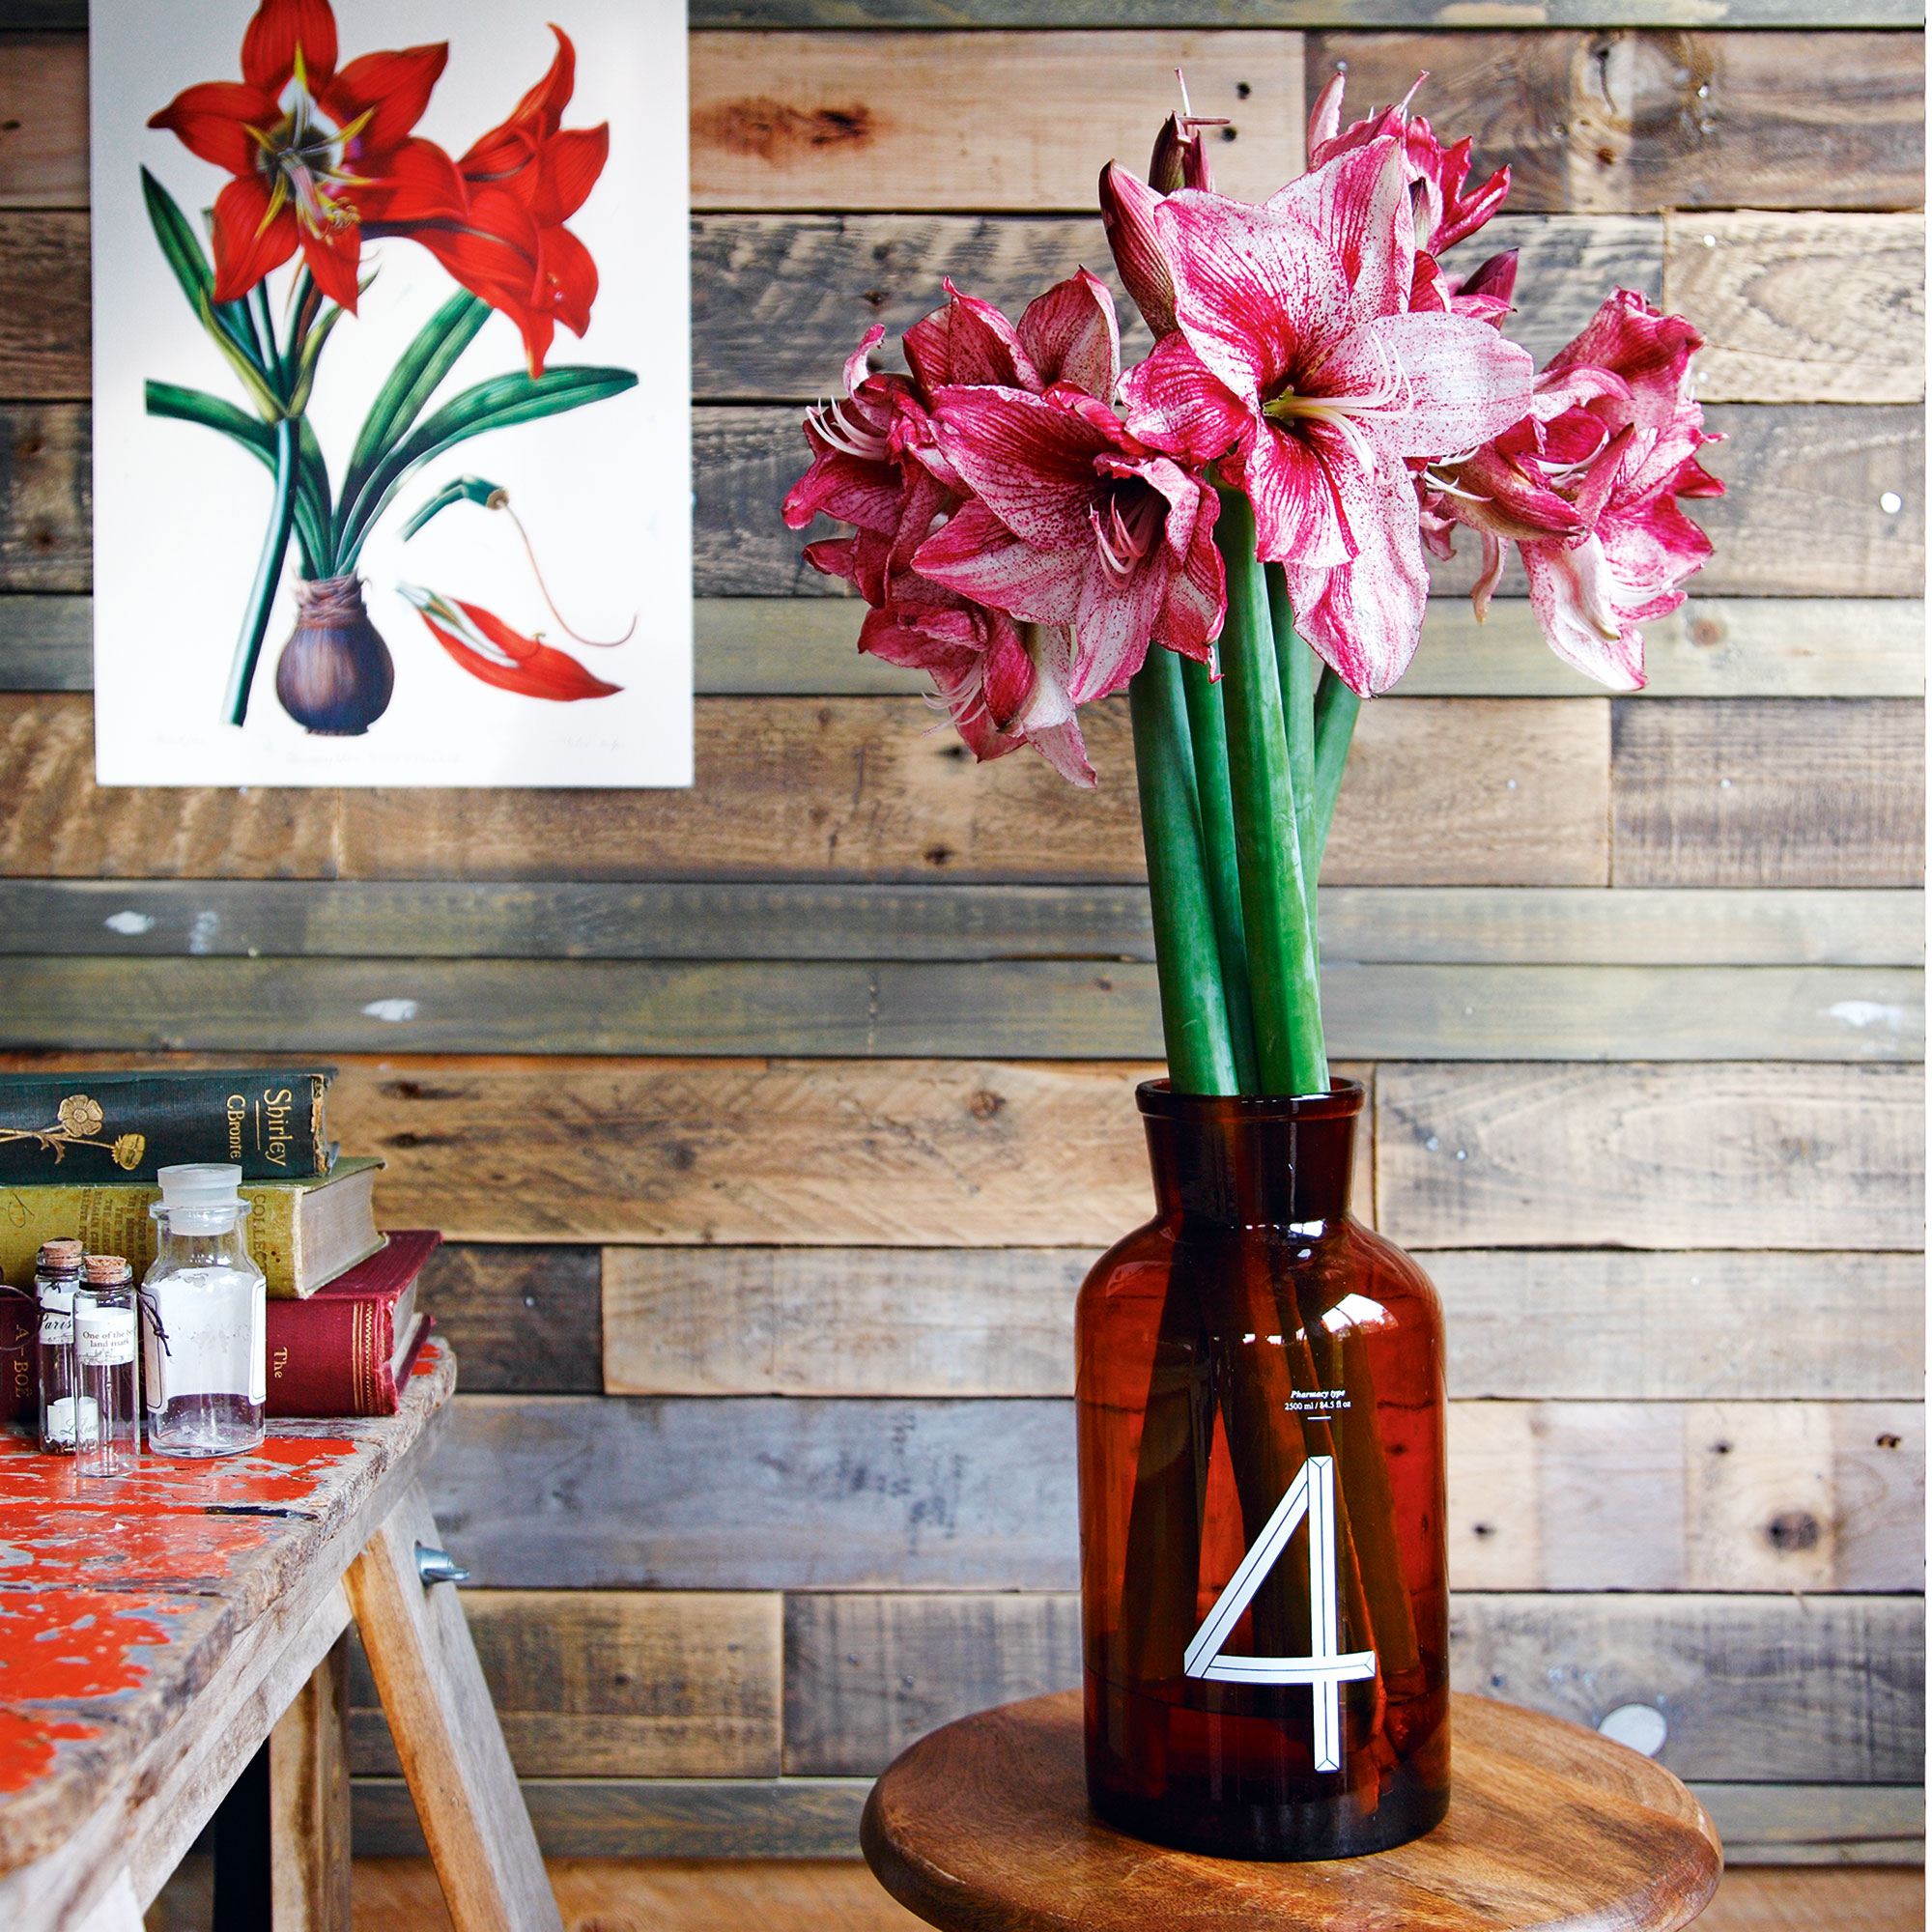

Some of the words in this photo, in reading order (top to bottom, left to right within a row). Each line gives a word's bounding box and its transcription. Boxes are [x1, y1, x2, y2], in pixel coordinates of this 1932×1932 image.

[264, 1088, 294, 1166] Shirley
[253, 1194, 268, 1274] COLLECT
[82, 1330, 99, 1339] One
[273, 1347, 288, 1378] The
[1284, 1402, 1303, 1410] 2500
[1303, 1402, 1314, 1410] ml
[1319, 1401, 1335, 1409] 84.5
[1335, 1400, 1342, 1408] fl
[1291, 1390, 1329, 1399] Pharmacy
[1329, 1389, 1346, 1399] type
[1183, 1455, 1377, 1773] 4
